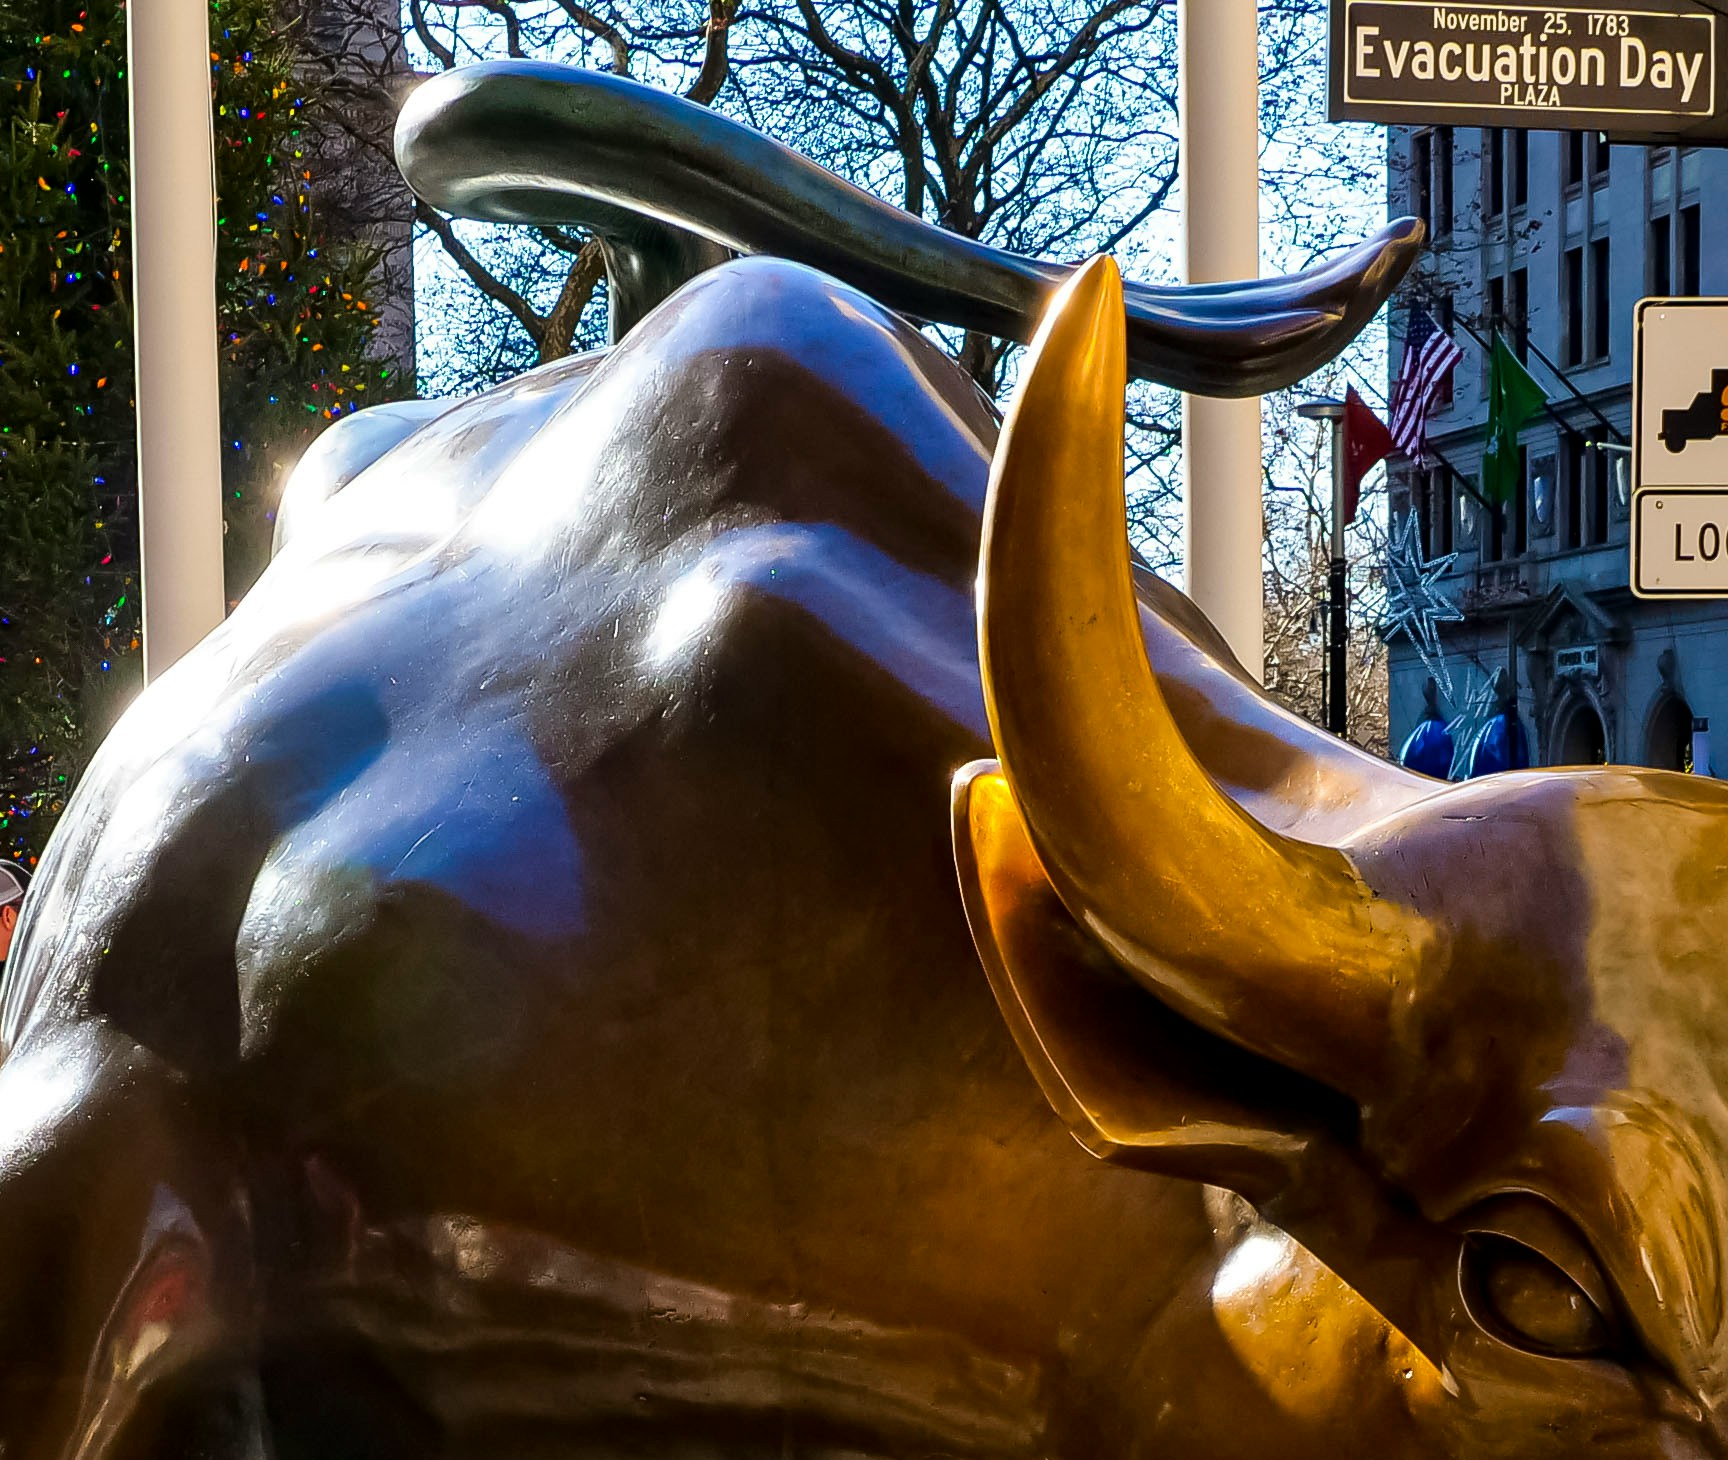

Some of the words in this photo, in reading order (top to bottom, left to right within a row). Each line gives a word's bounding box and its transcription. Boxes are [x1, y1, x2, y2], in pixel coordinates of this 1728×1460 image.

[1433, 8, 1528, 33] November
[1587, 15, 1630, 36] 1783
[1355, 26, 1606, 87] Evacuation
[1619, 37, 1704, 103] Day
[1500, 84, 1561, 107] PLAZA
